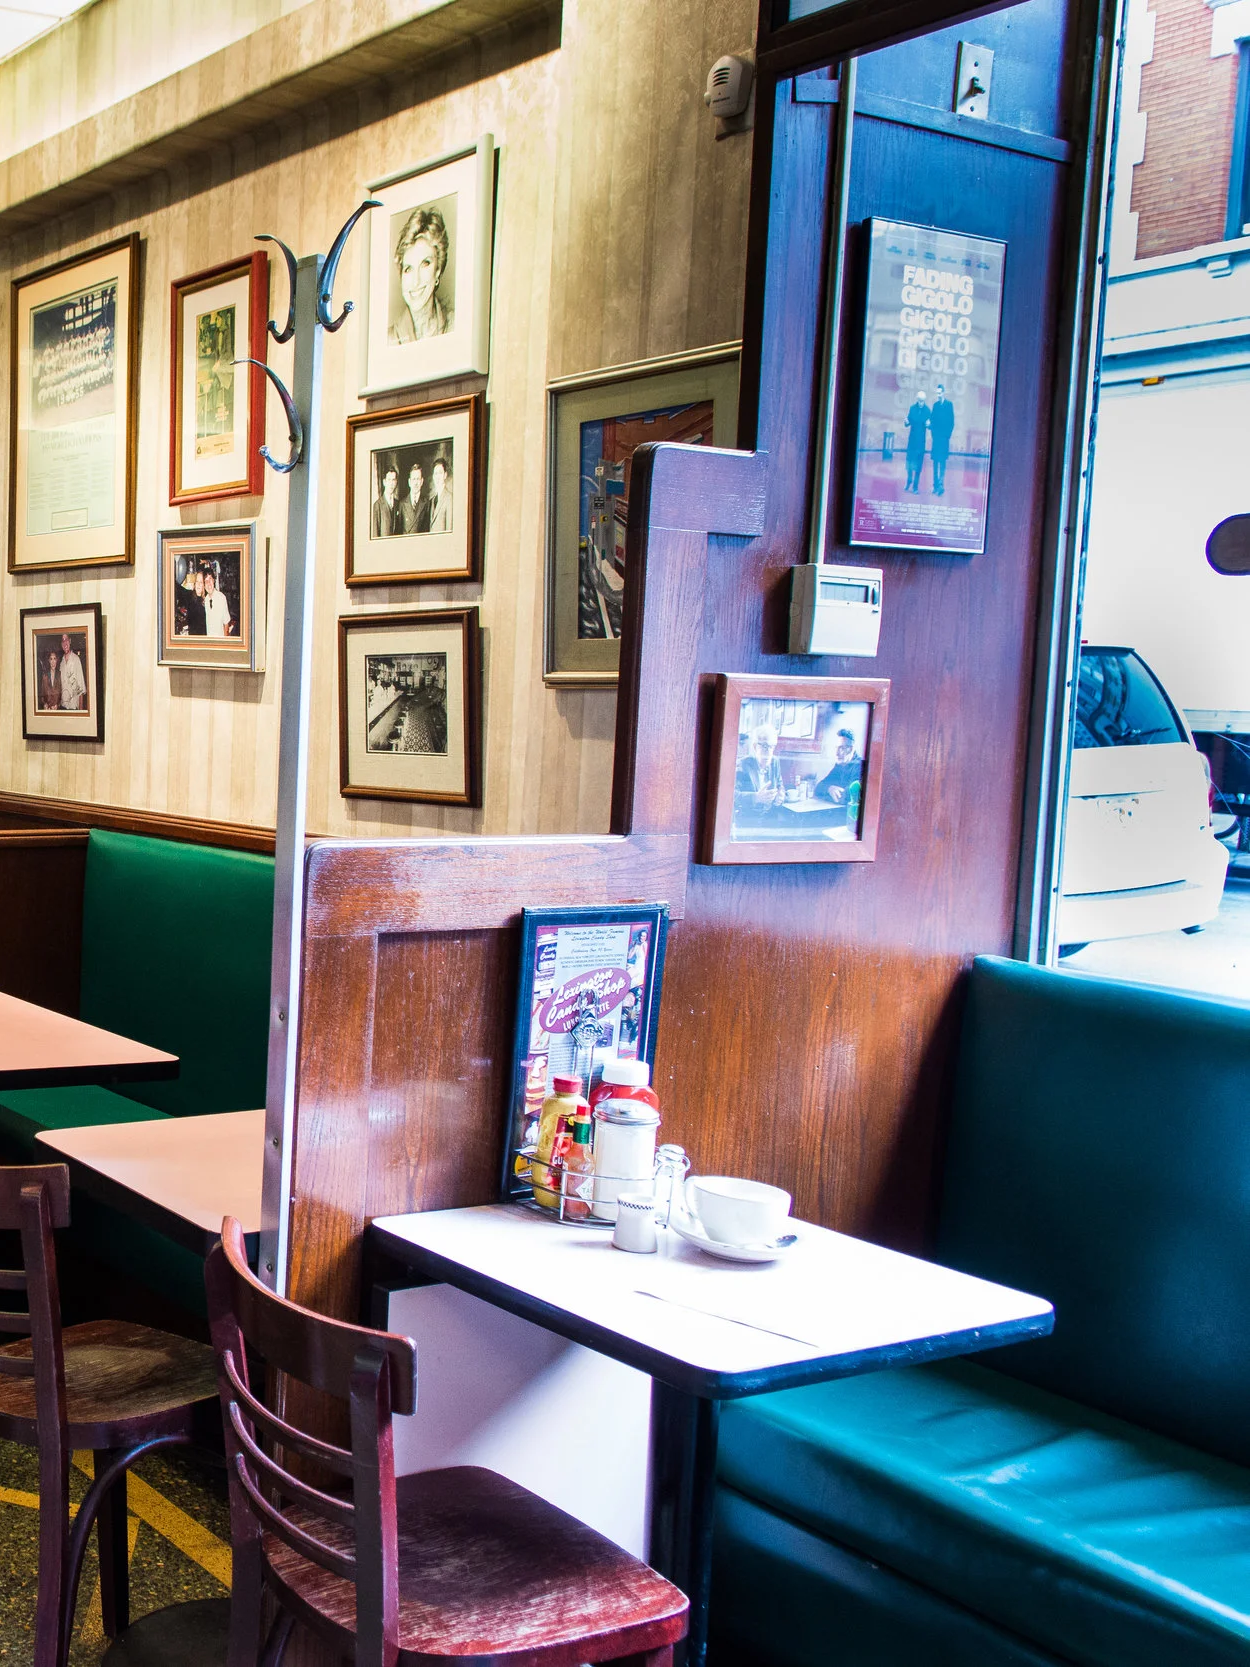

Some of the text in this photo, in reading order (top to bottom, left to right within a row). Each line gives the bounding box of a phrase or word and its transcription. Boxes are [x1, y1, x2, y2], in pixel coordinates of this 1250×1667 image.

[903, 264, 974, 296] FADING
[901, 285, 973, 315] GIGOLO
[900, 307, 972, 336] GIGOLO
[899, 328, 970, 356] GIGOLO
[898, 348, 968, 376] GIGOLO
[552, 968, 614, 1006] Lexington
[596, 977, 626, 999] Shop
